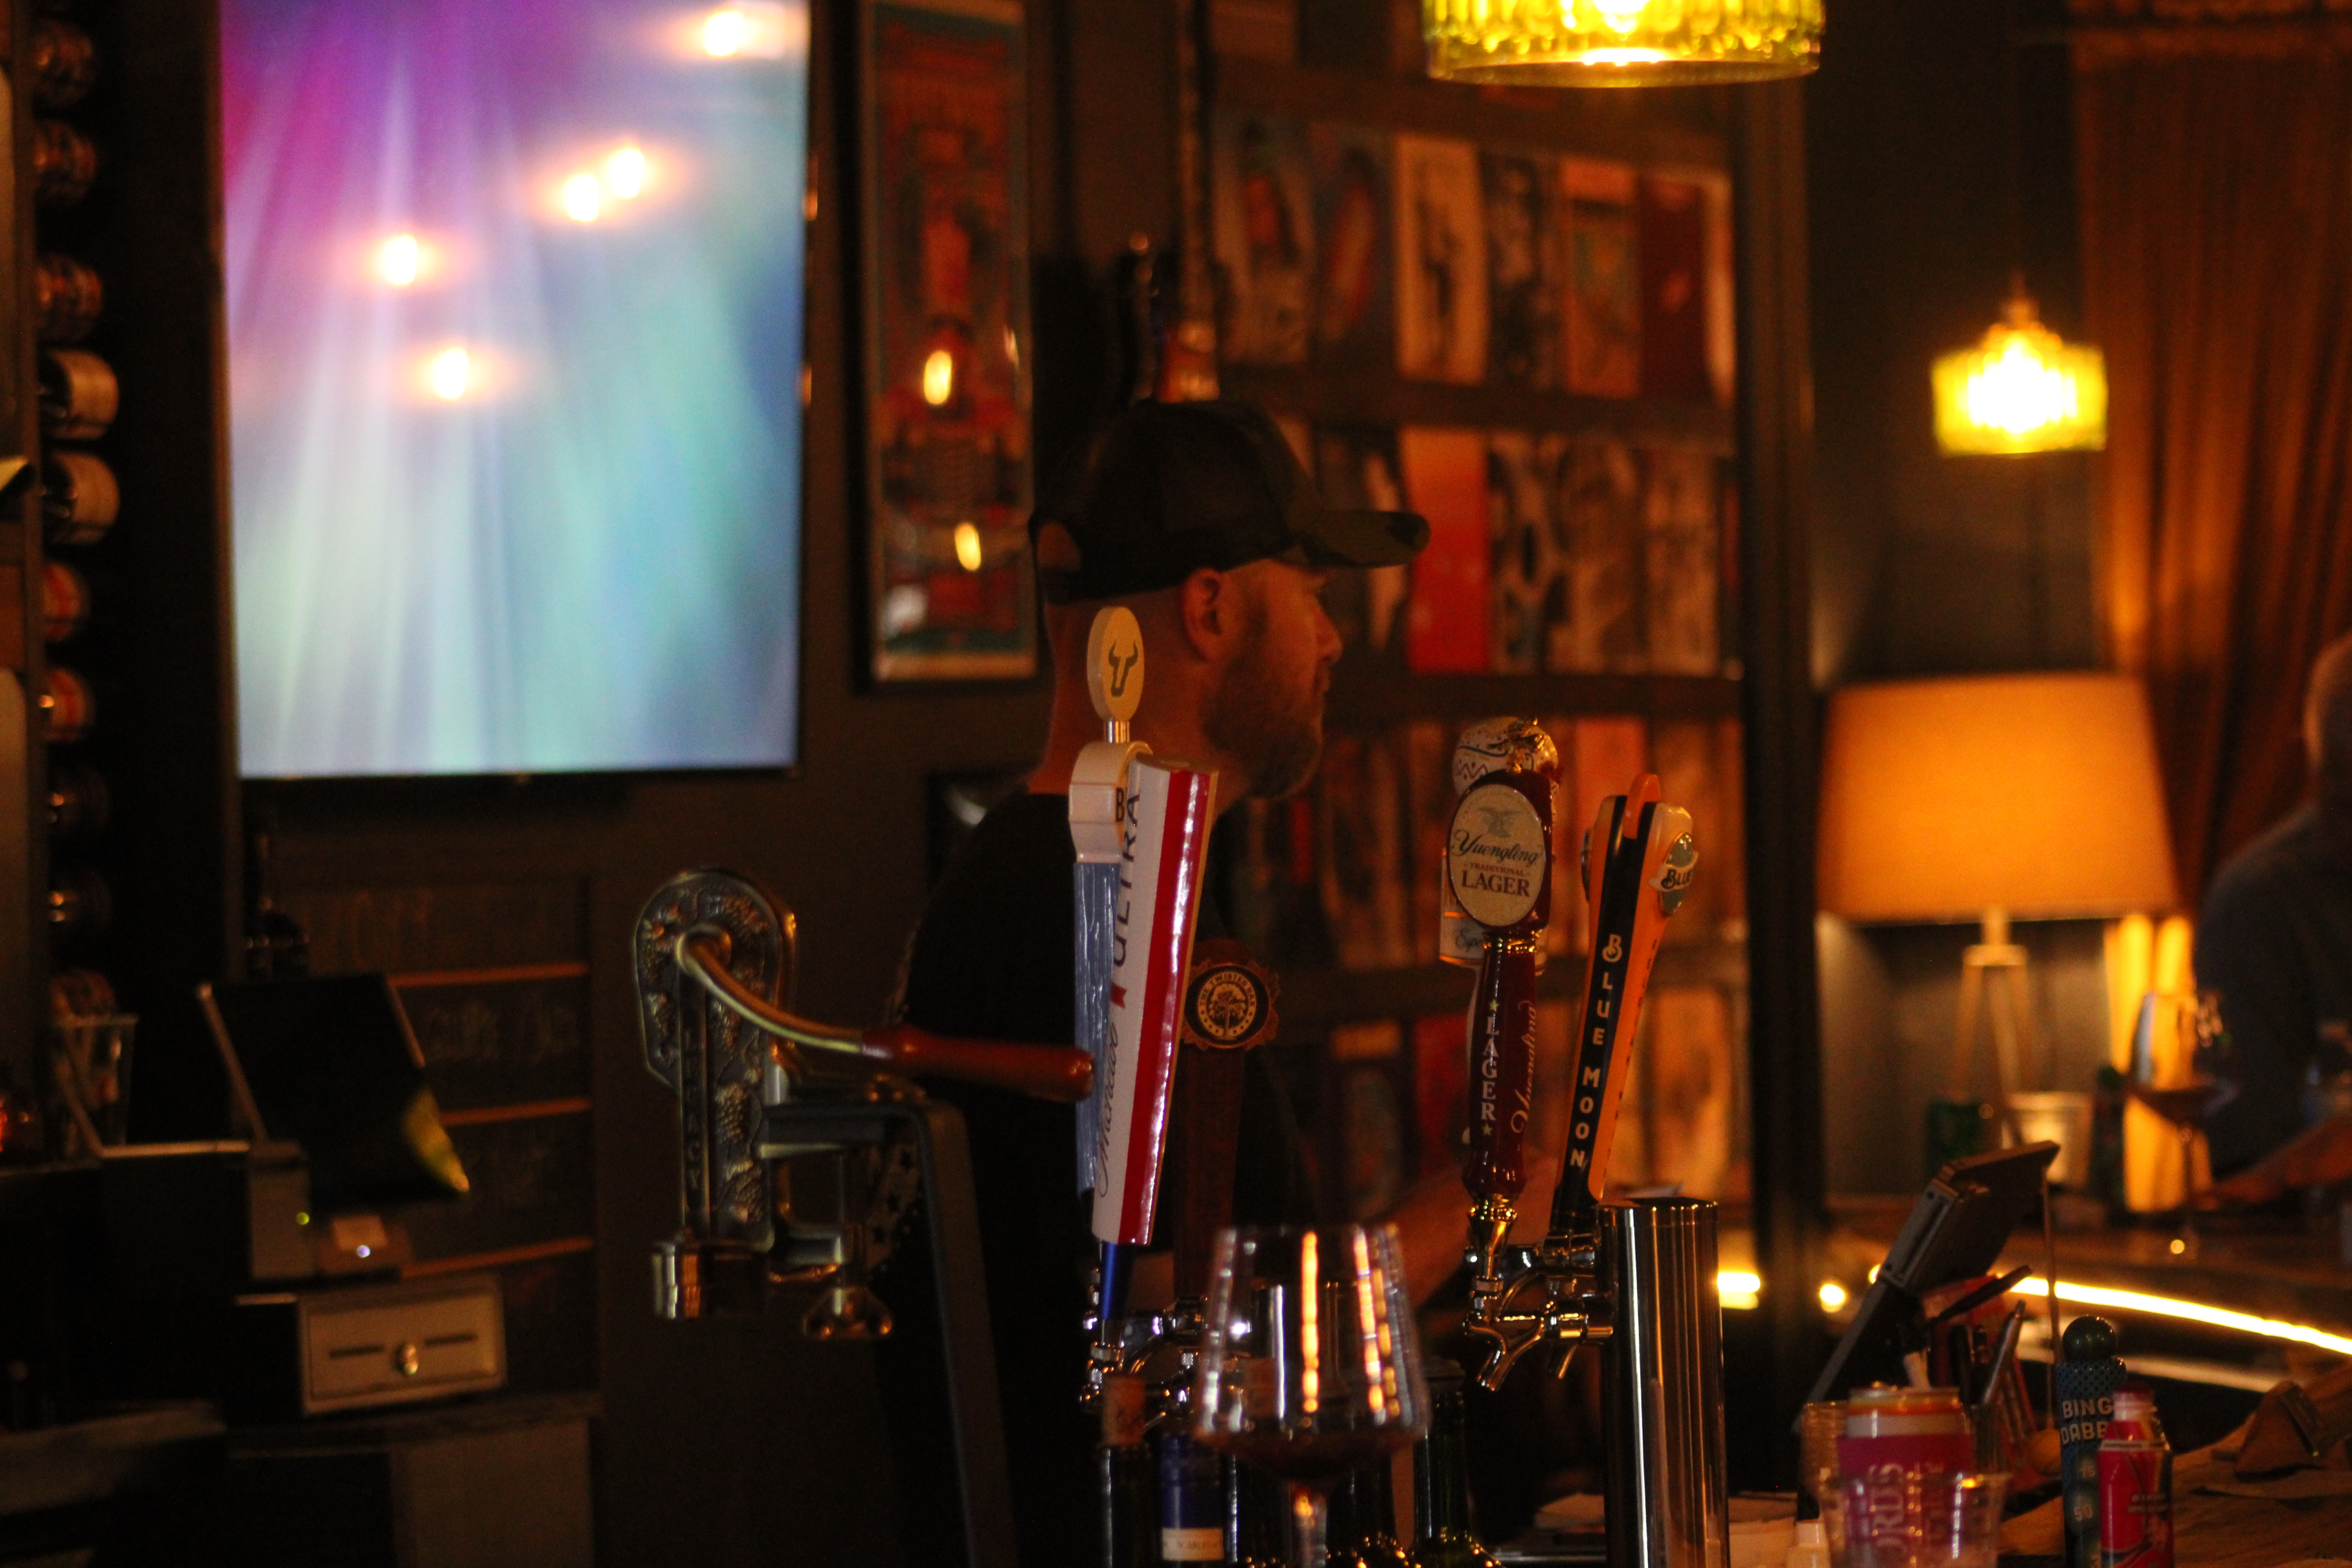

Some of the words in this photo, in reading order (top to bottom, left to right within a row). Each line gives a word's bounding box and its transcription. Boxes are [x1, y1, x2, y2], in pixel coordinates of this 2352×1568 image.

[1116, 788, 1126, 822] B
[1451, 829, 1544, 868] Yuengling
[1462, 870, 1530, 897] LAGER
[1592, 934, 1622, 1046] BLUE
[1481, 1016, 1499, 1122] LAGER
[1570, 1066, 1601, 1168] MOON
[2062, 1397, 2113, 1419] BING
[2061, 1421, 2109, 1446] DABB
